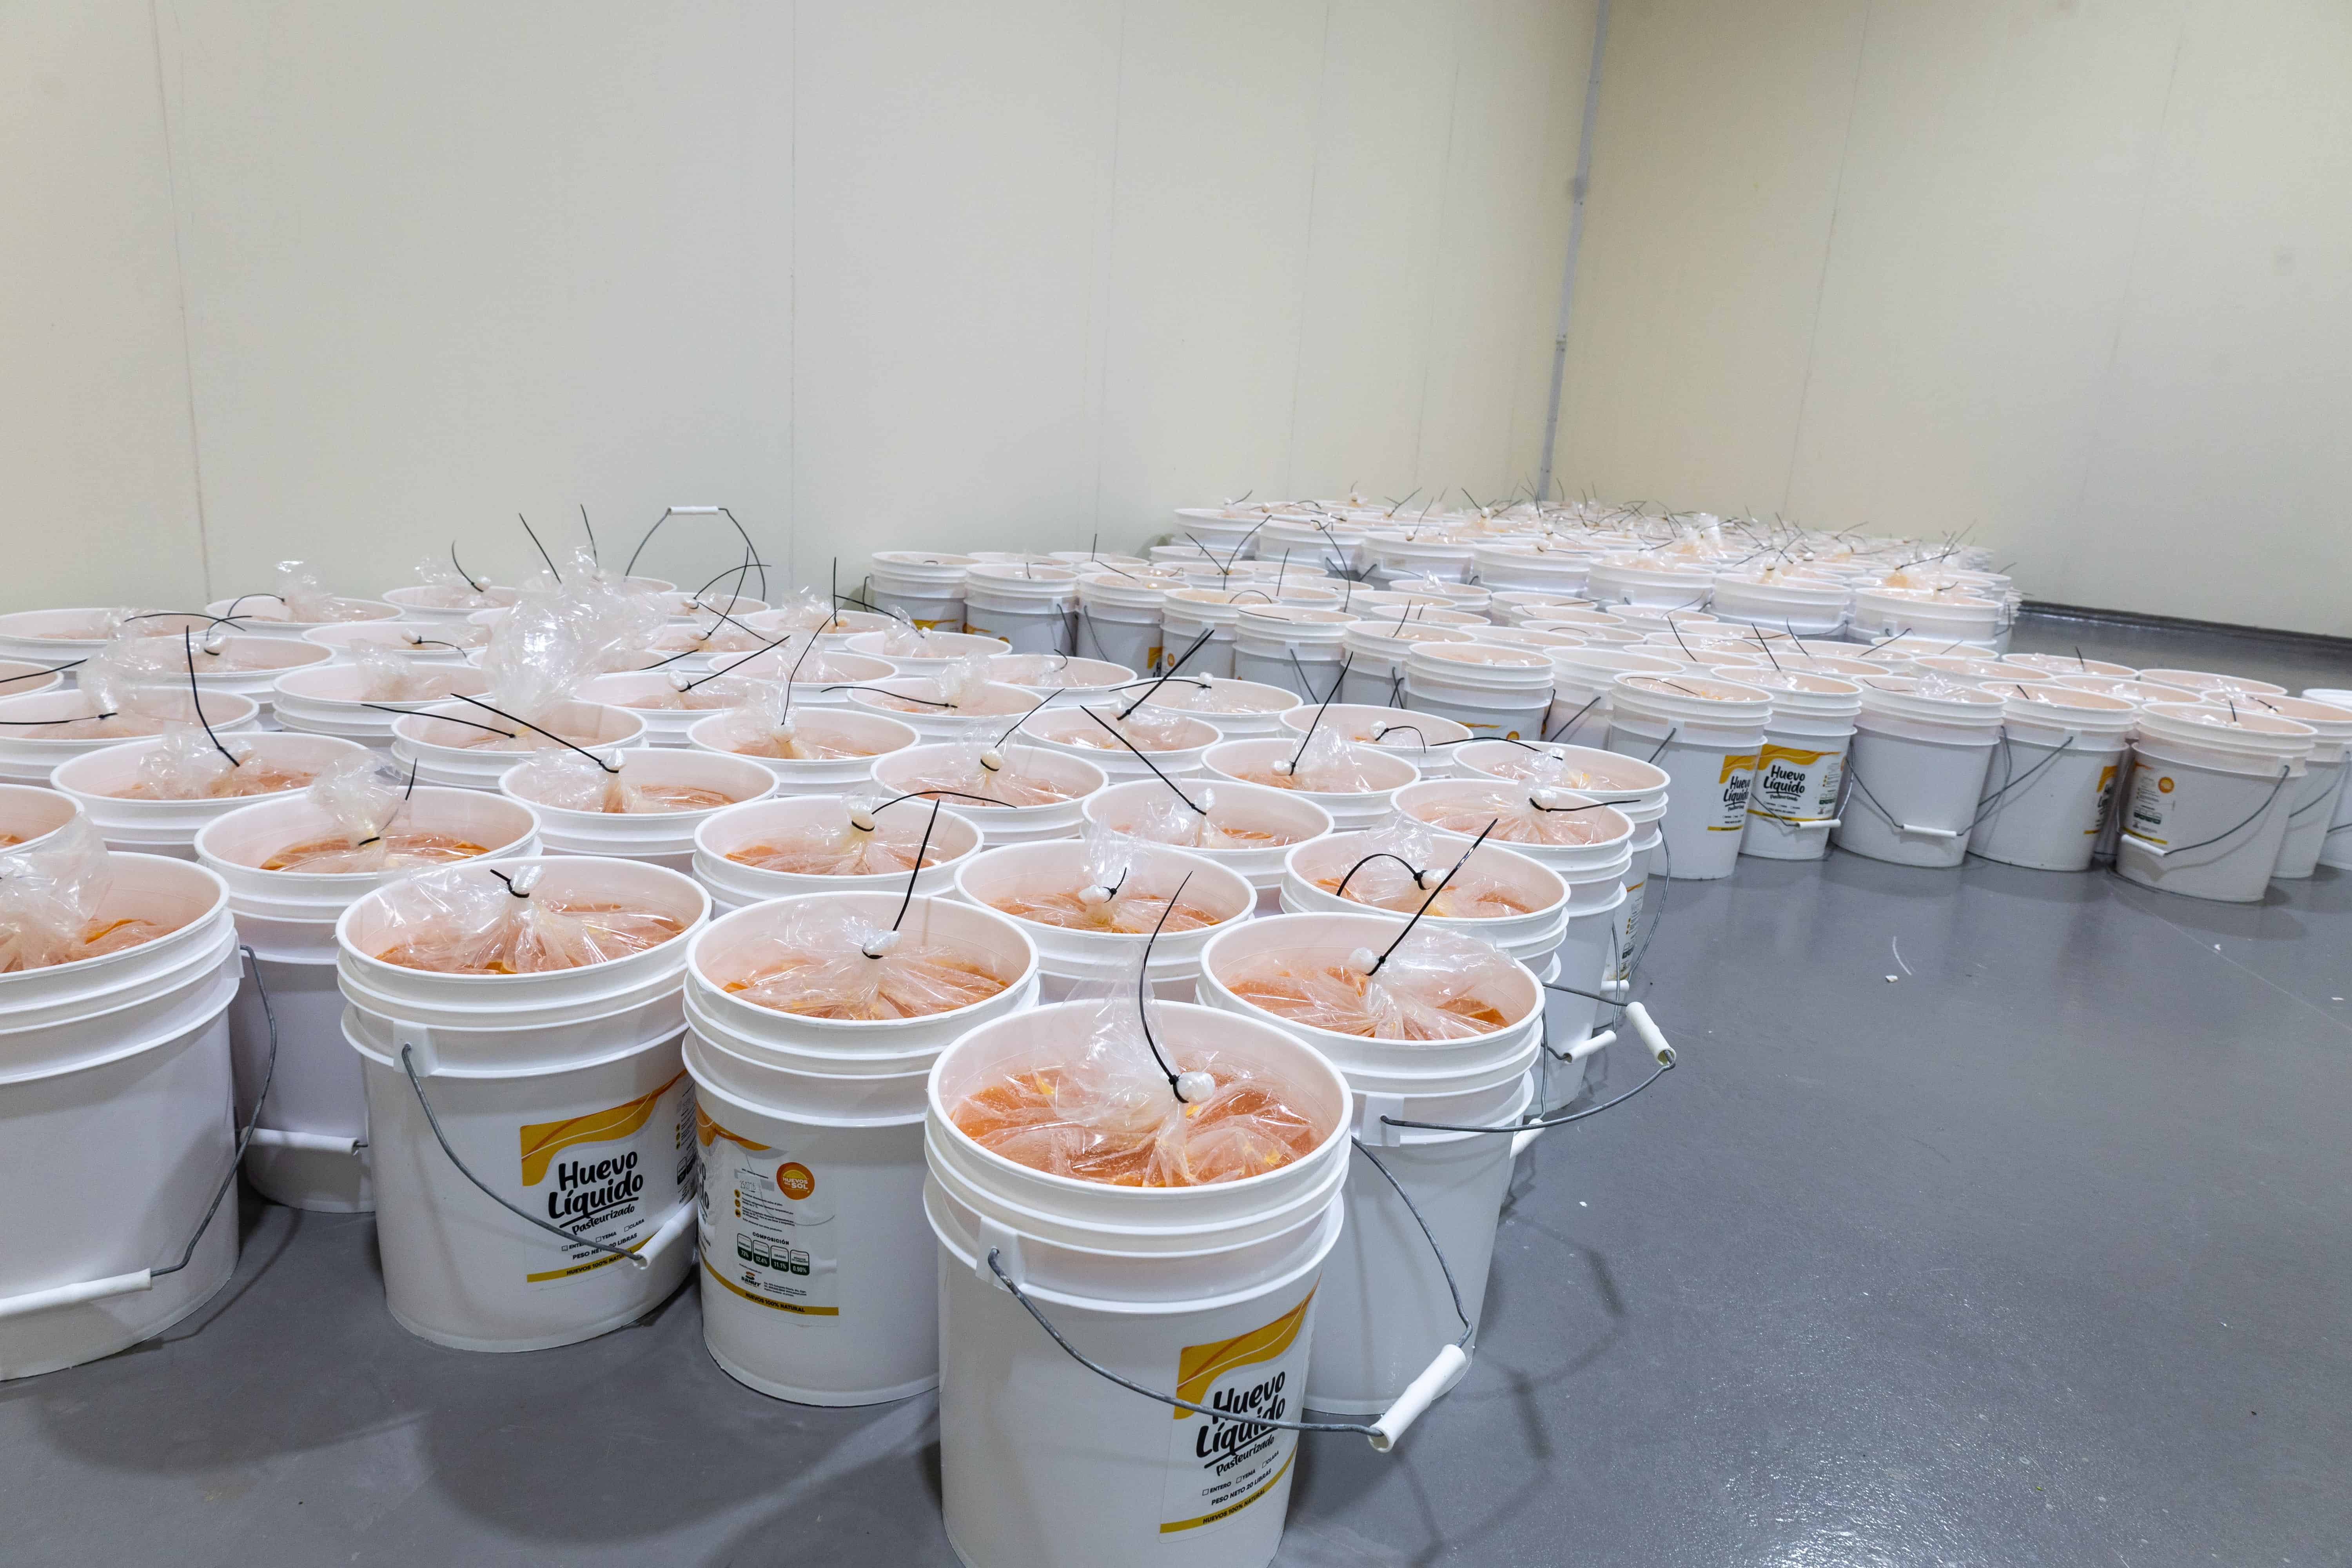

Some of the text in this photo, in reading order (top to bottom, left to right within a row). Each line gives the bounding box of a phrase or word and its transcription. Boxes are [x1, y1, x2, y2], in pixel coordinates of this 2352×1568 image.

[1764, 776, 1805, 796] Líquido
[1771, 765, 1805, 781] Huevo
[559, 1152, 638, 1191] Huevo
[548, 1171, 644, 1219] Líquido
[572, 1204, 635, 1235] Pasteurizado
[602, 1231, 617, 1240] YEMA
[629, 1219, 644, 1229] CLARA
[573, 1251, 590, 1260] PESO
[618, 1232, 637, 1245] LIBRAS
[753, 1232, 789, 1245] COMPOSICIÓN
[566, 1264, 591, 1275] HUEVOS
[592, 1258, 608, 1268] 100%
[745, 1292, 764, 1303] HUEVOS
[765, 1299, 779, 1308] 100%
[780, 1304, 806, 1312] NATURAL
[1212, 1371, 1285, 1425] Huevo
[1196, 1394, 1285, 1458] Líquido
[1210, 1450, 1279, 1493] ENTERO YEMA CLARA
[1216, 1434, 1274, 1477] Pasteurizado
[1212, 1468, 1272, 1506] PESO NETO 20 LIBRAS
[1203, 1489, 1265, 1524] HUEVOS 100% NATURAL
